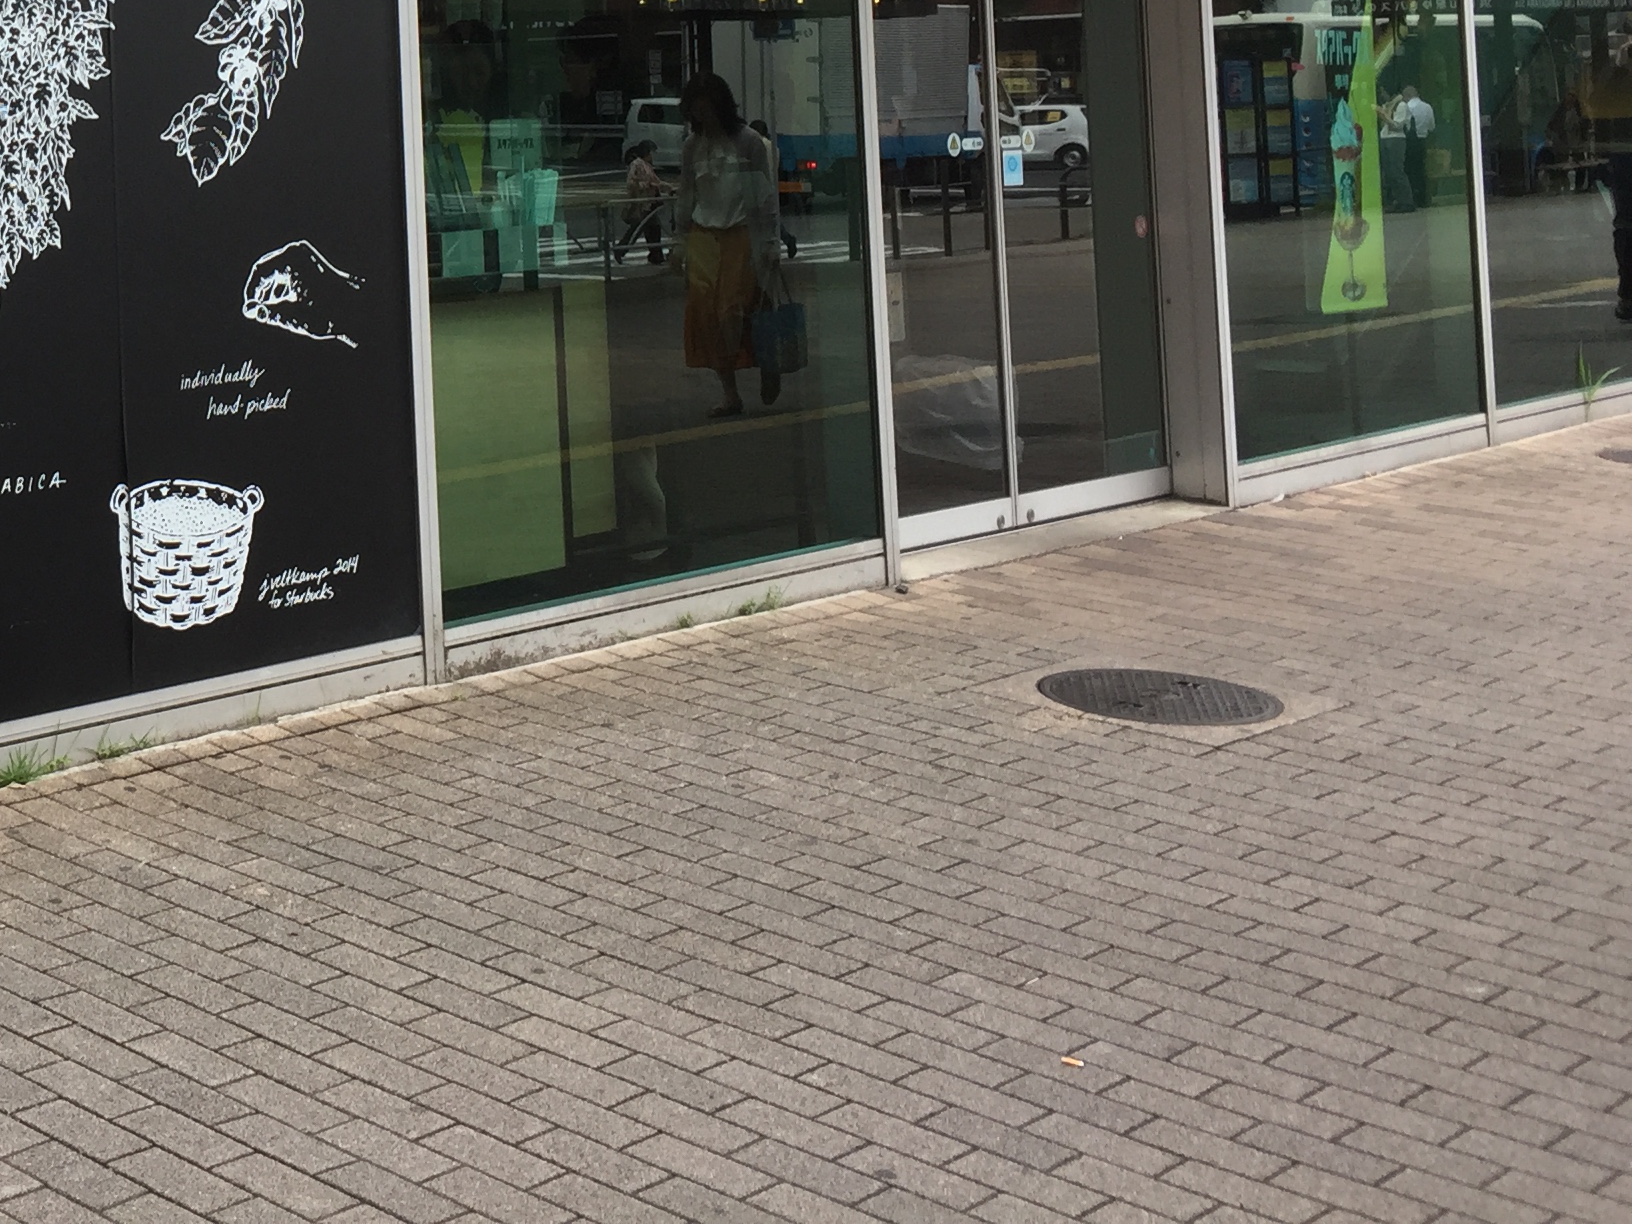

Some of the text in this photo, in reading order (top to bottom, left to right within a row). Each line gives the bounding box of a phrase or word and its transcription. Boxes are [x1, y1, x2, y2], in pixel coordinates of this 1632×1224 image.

[179, 358, 266, 391] individually
[206, 387, 292, 420] hand-picked
[333, 554, 360, 575] 2014
[268, 581, 335, 609] for Starbucks
